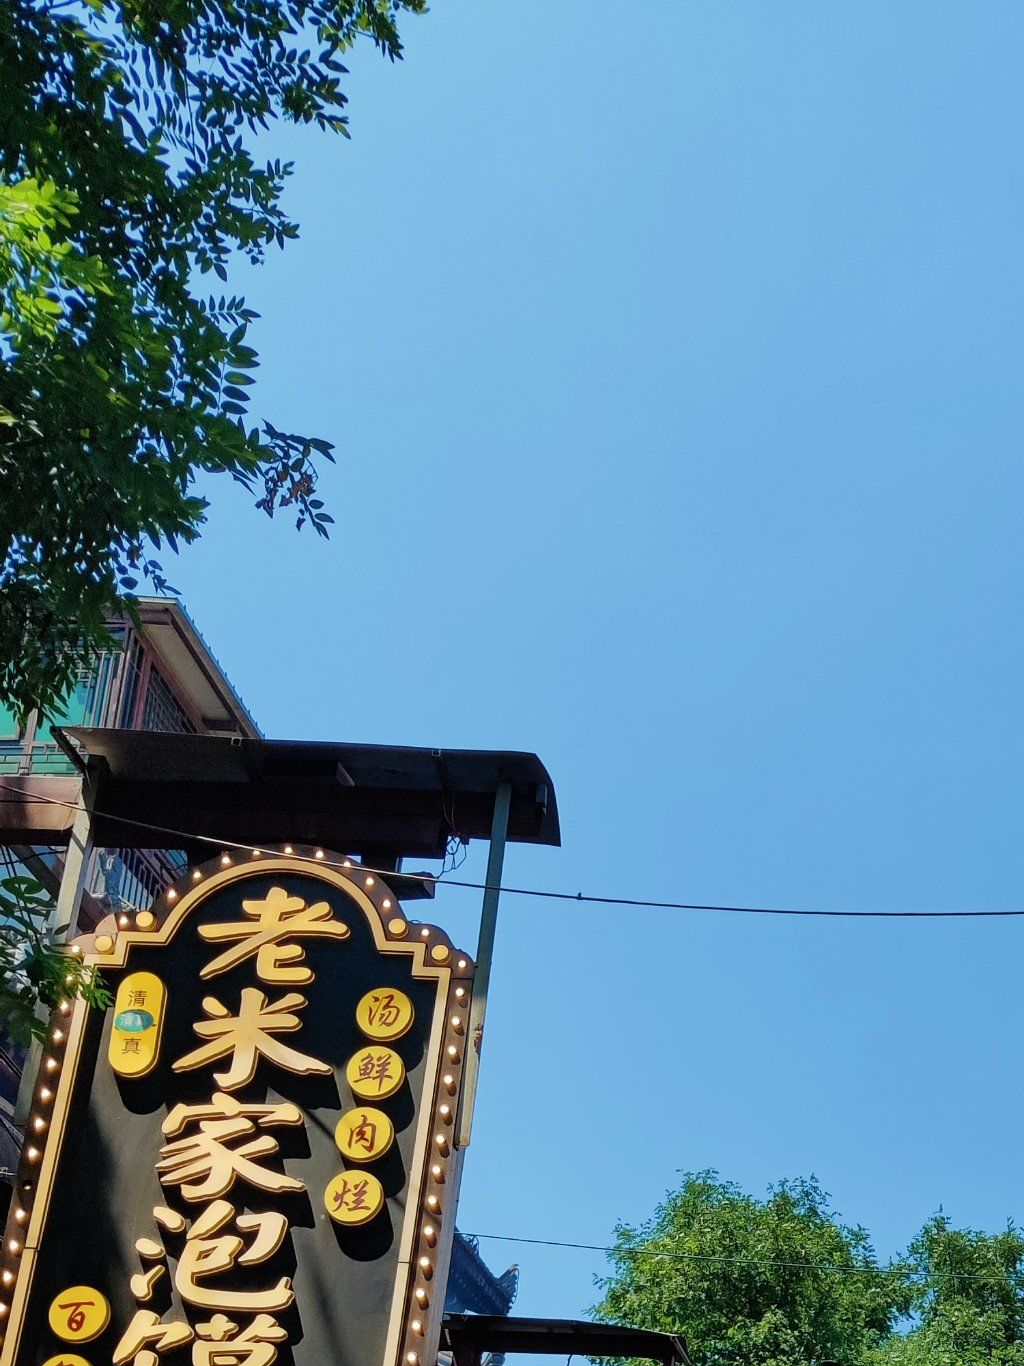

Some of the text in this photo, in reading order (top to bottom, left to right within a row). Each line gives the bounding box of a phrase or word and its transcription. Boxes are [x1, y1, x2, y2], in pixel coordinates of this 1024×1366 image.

[122, 989, 148, 1055] 清真
[332, 994, 401, 1212] 汤鲜肉烂
